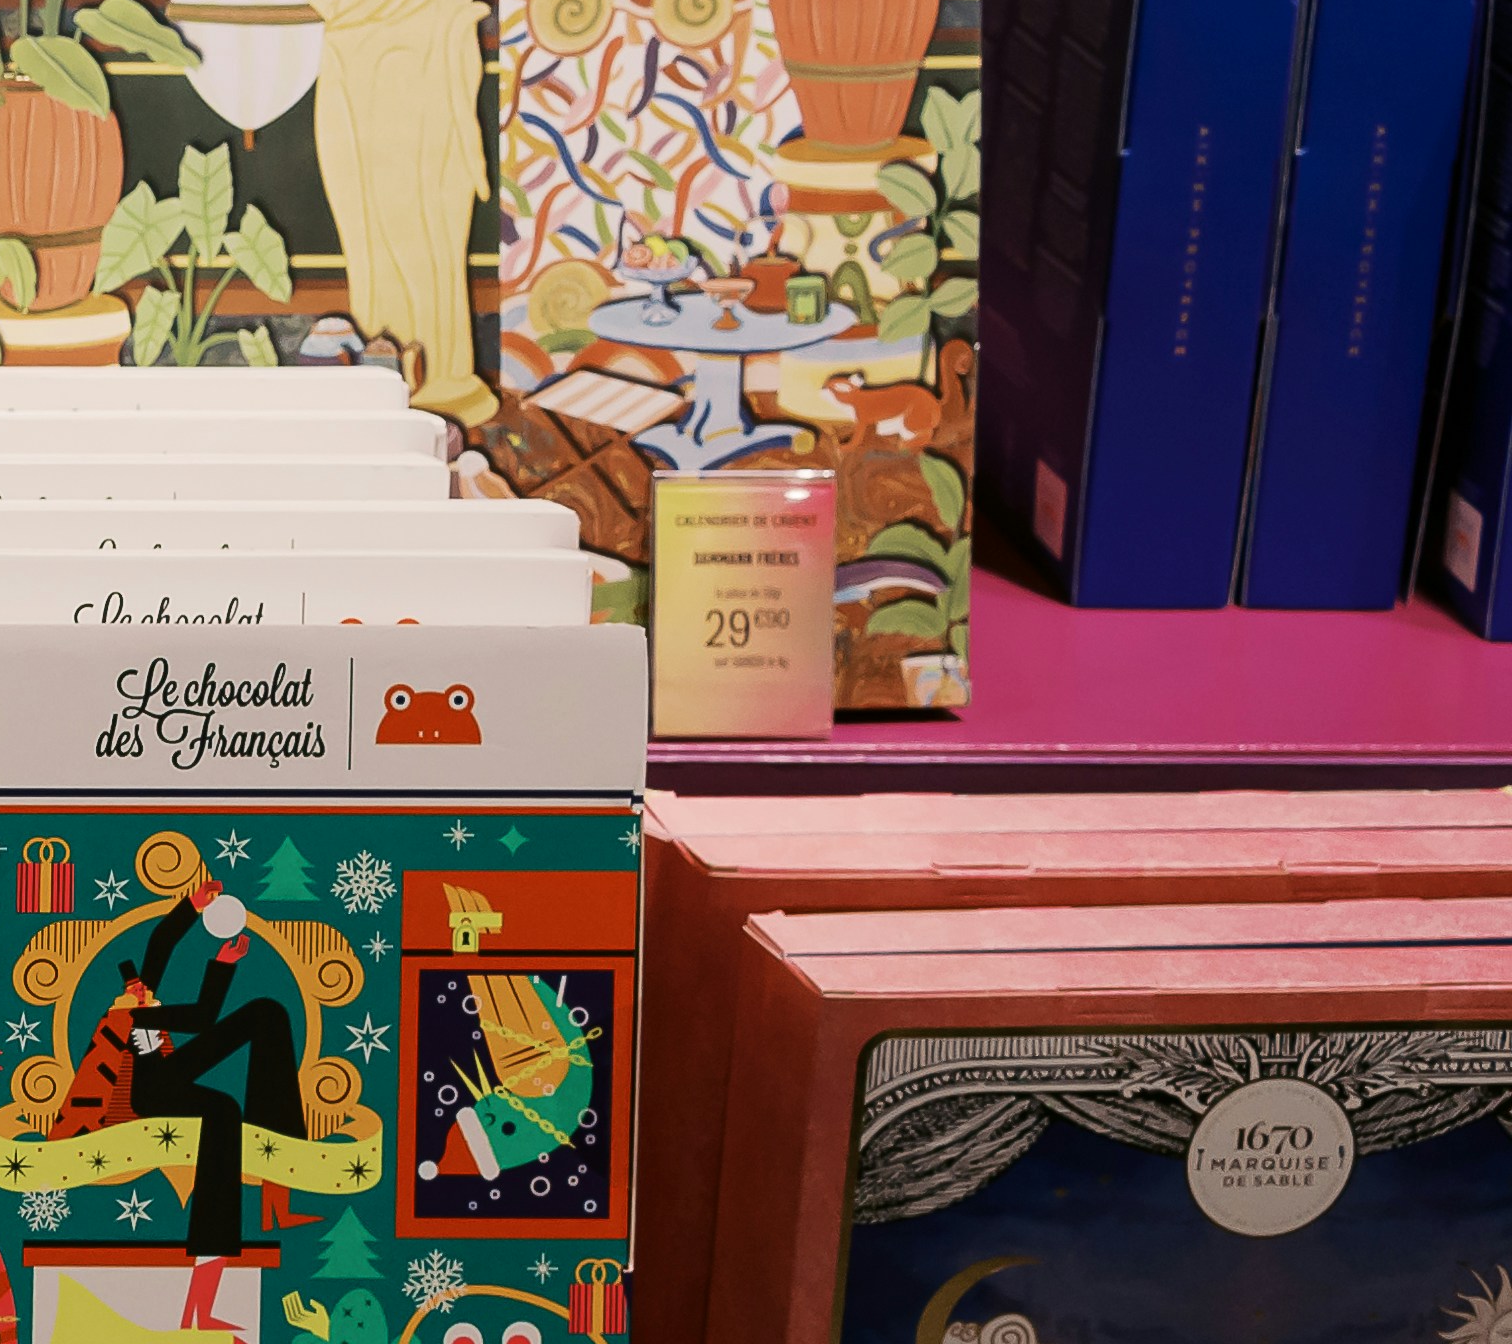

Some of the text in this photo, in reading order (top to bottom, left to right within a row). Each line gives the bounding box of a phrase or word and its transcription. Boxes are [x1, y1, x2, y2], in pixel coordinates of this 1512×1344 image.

[705, 609, 752, 650] 29
[116, 657, 314, 720] Le chocolat
[95, 708, 326, 771] des Français
[1236, 1120, 1314, 1155] 1670
[1210, 1156, 1330, 1172] MARQUISE
[1222, 1175, 1247, 1188] DE
